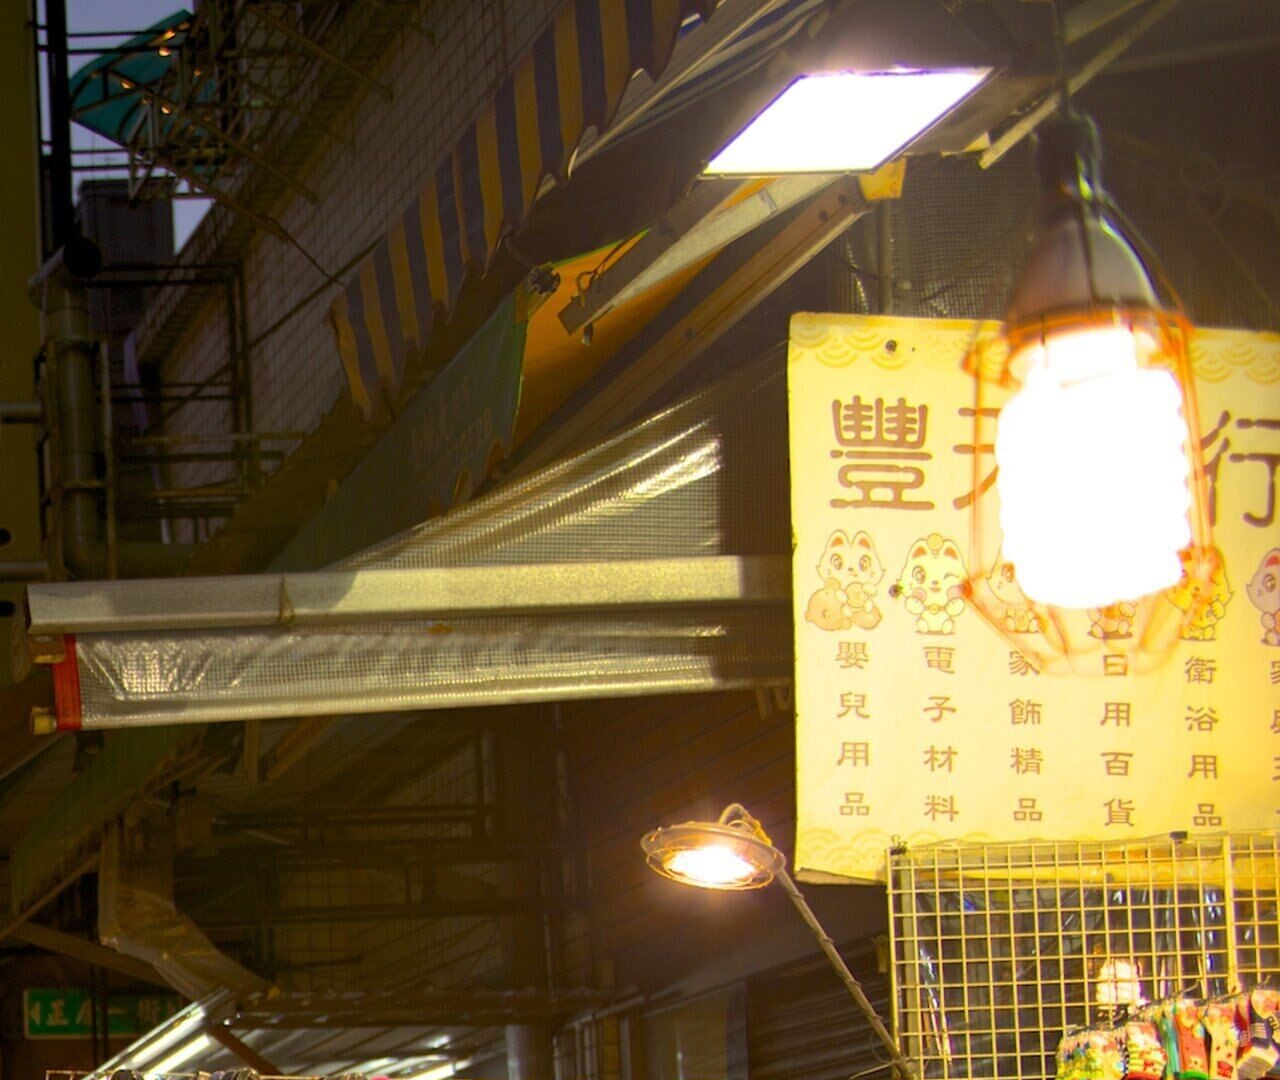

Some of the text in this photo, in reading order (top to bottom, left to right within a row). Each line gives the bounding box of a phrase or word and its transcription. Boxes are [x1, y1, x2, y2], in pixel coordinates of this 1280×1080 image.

[834, 640, 871, 819] 嬰兒用品
[922, 646, 960, 823] 電子材料
[1009, 648, 1044, 823] 家飾精品
[1100, 653, 1136, 828] 日用百貨
